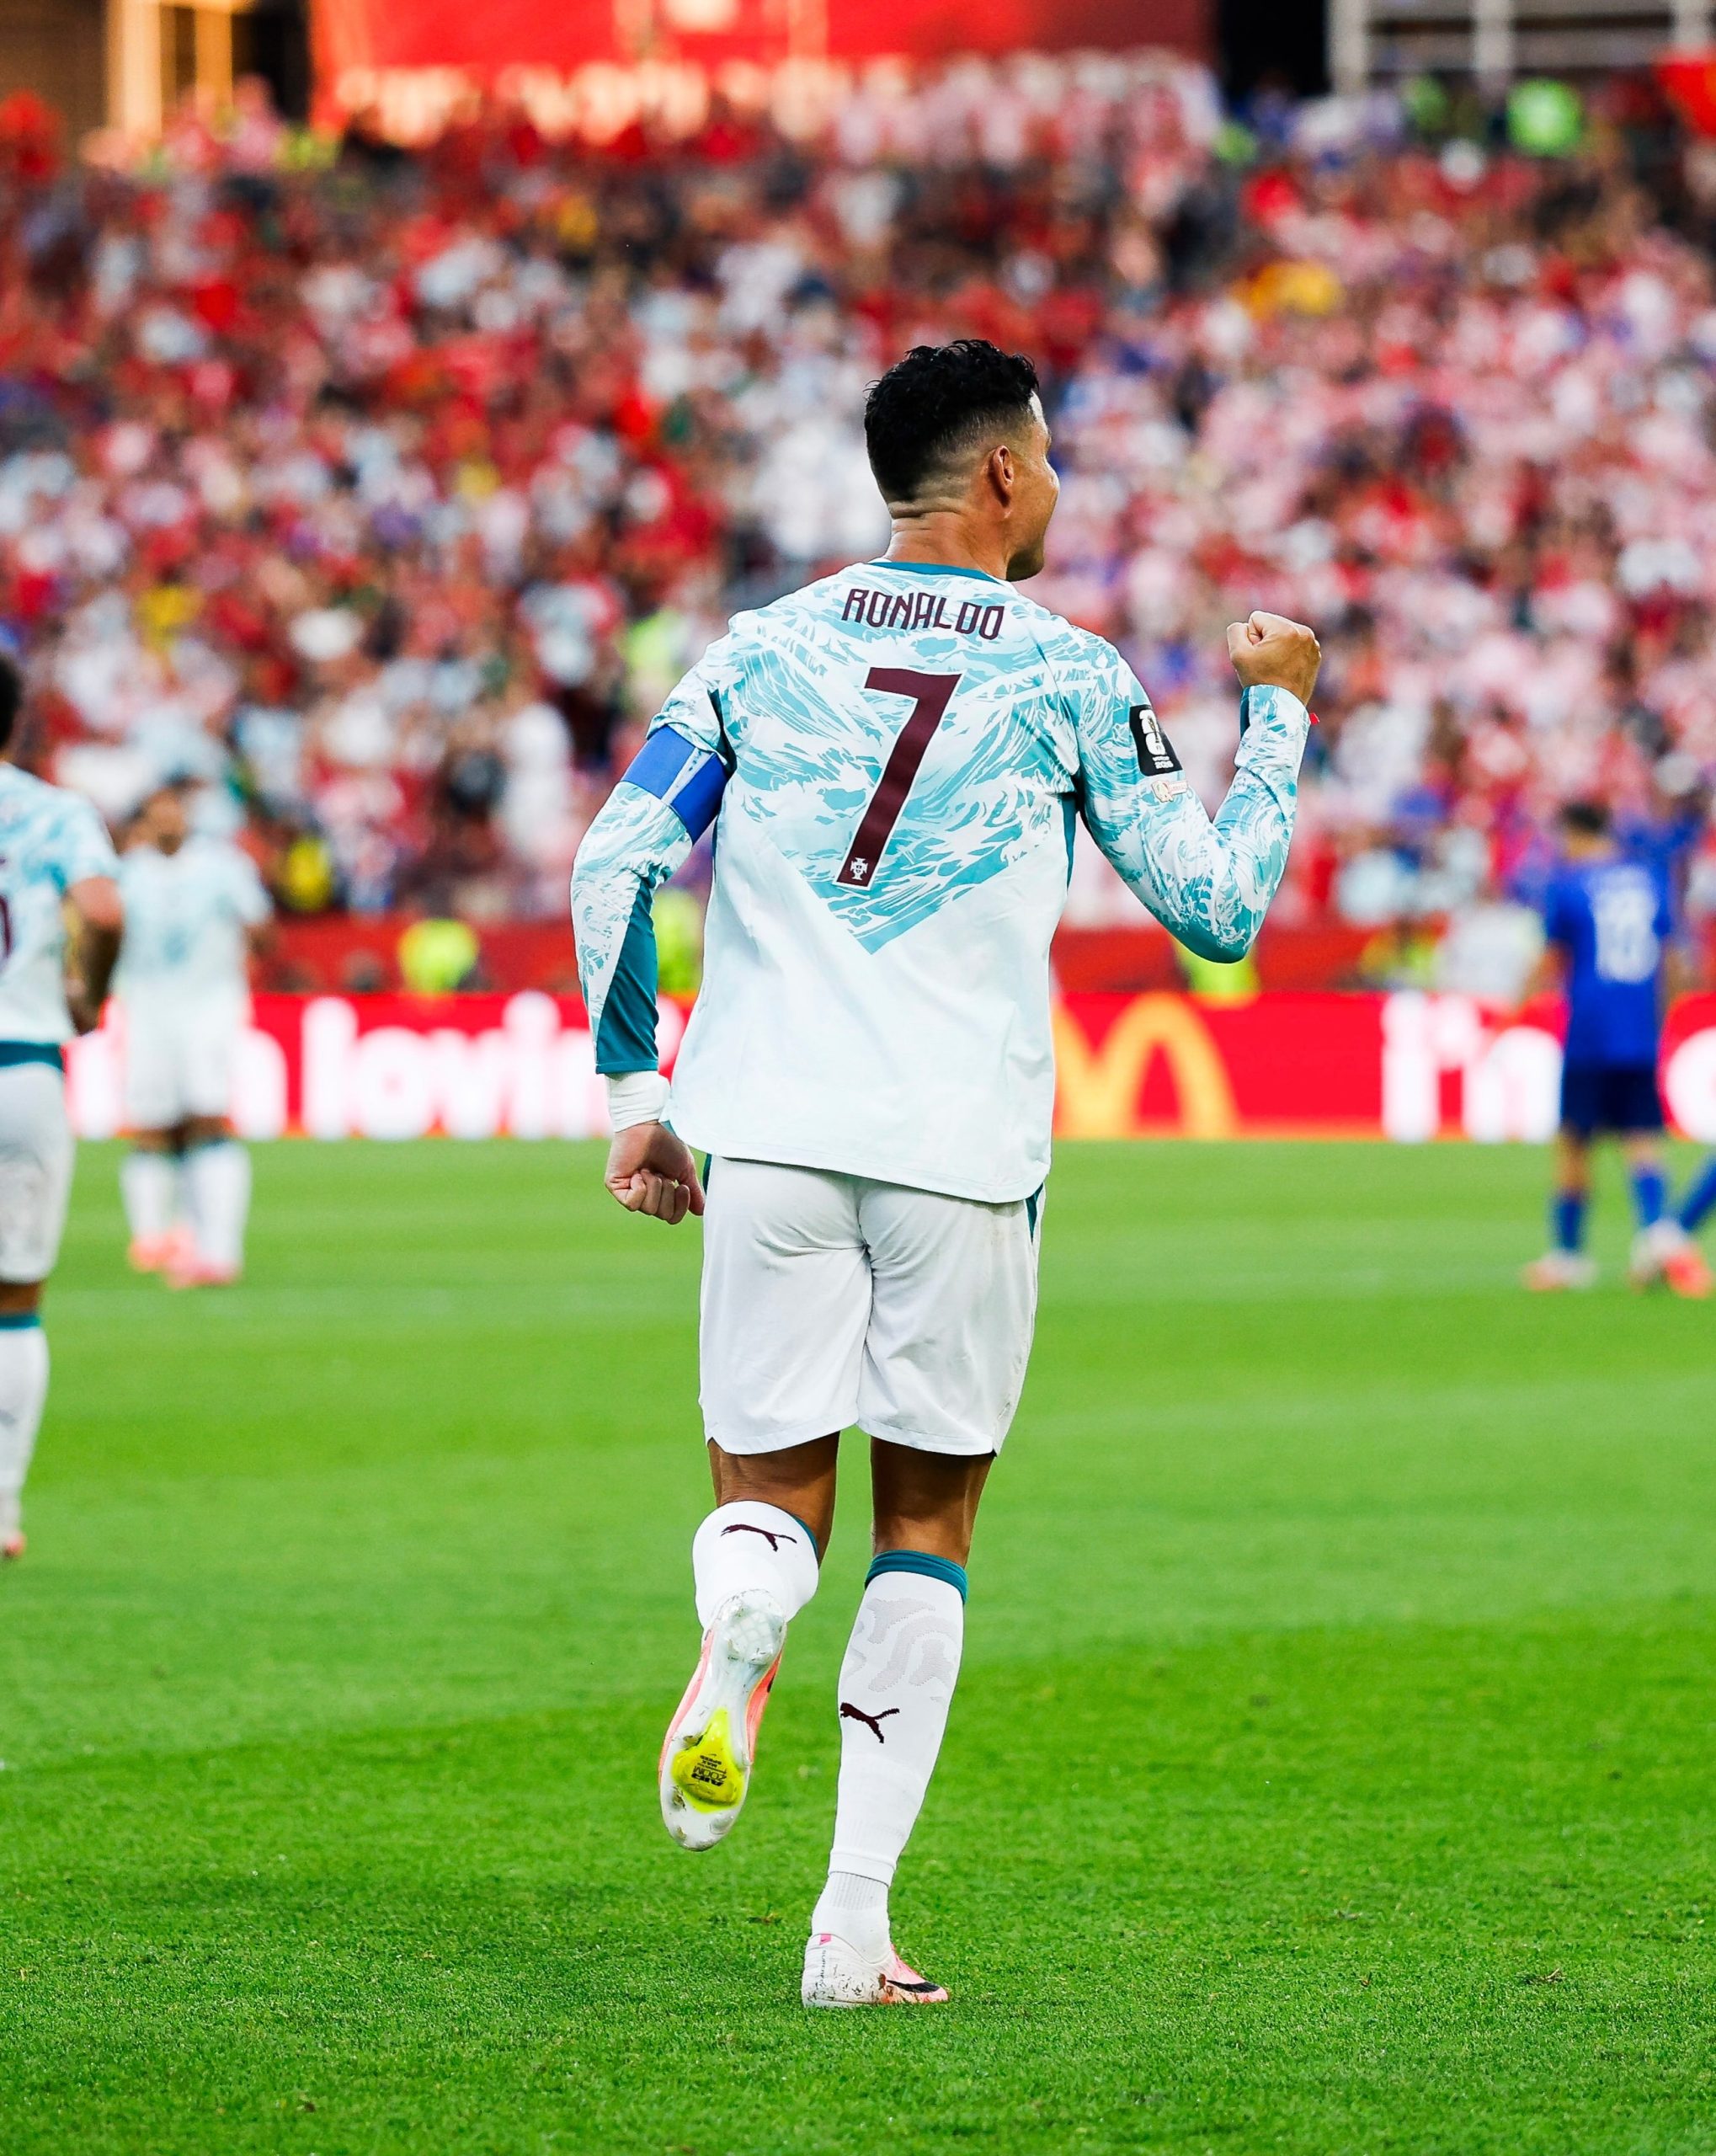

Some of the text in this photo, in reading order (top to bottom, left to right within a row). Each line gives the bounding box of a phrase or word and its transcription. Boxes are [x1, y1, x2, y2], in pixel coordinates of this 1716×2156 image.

[841, 588, 1005, 640] RONALDO
[836, 666, 962, 889] 7
[691, 1773, 724, 1786] AIR
[693, 1765, 727, 1782] ZOOM
